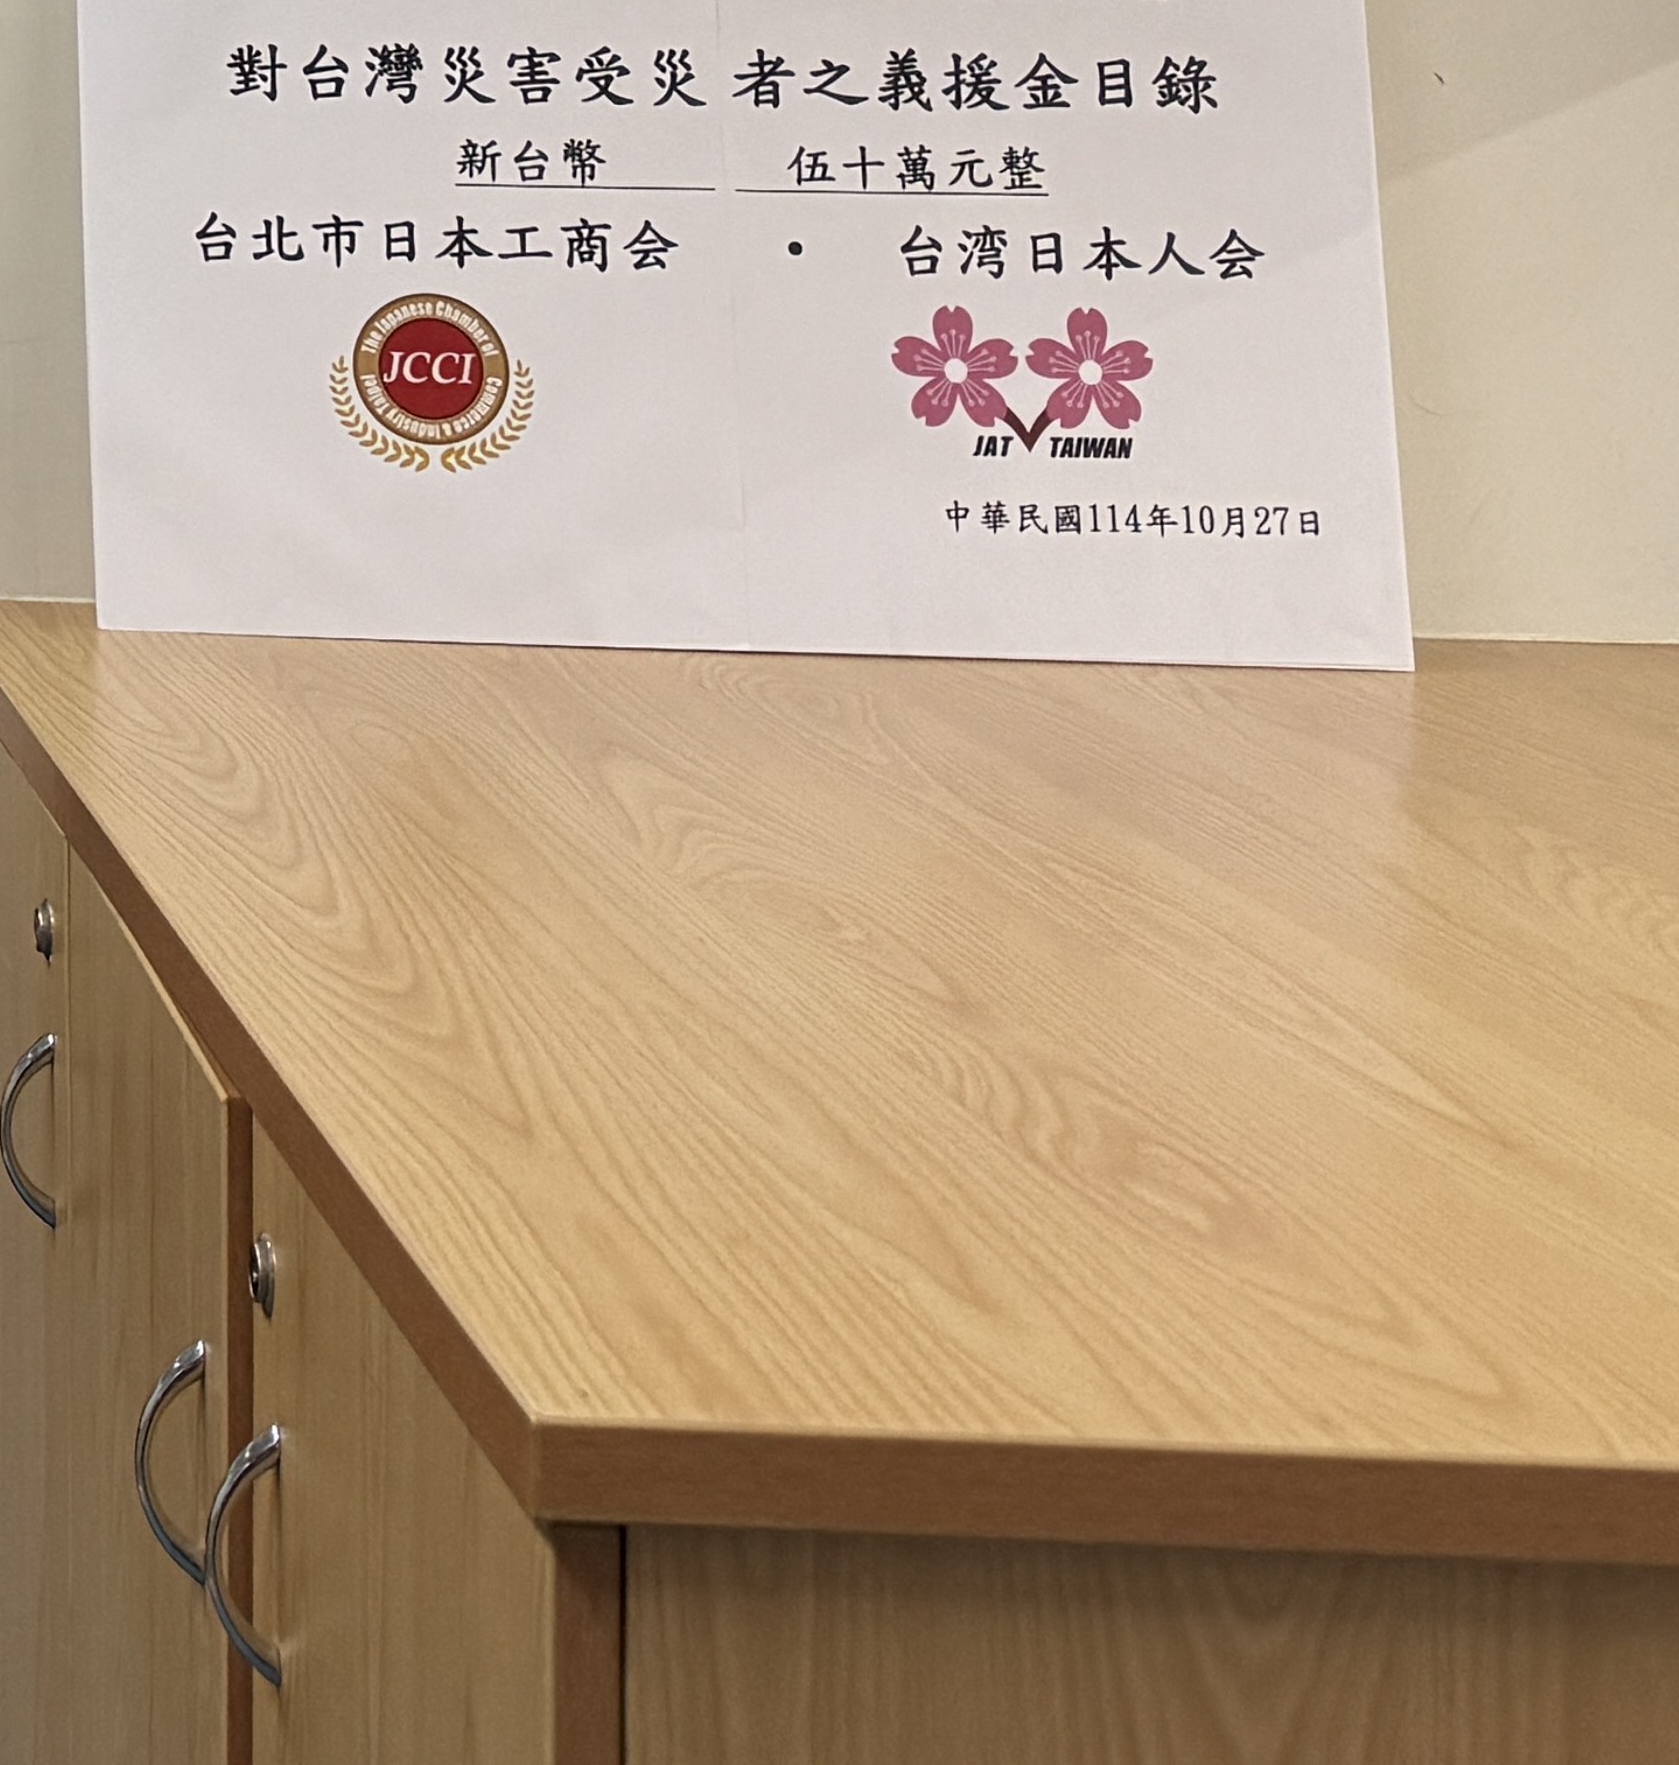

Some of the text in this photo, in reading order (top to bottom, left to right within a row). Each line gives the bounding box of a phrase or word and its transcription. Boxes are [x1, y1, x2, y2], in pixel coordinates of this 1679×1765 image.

[226, 42, 1219, 115] 對台灣災害受災者之義援金目錄
[455, 137, 1045, 191] 新台幣 伍十萬元整
[194, 211, 680, 273] 台北市日本工商会
[899, 224, 1266, 281] 台湾日本人会
[360, 328, 384, 354] The
[382, 350, 477, 385] JCCI
[972, 435, 1133, 459] JAT TAIWAN
[944, 499, 1321, 538] 中華民國114年10月27日
